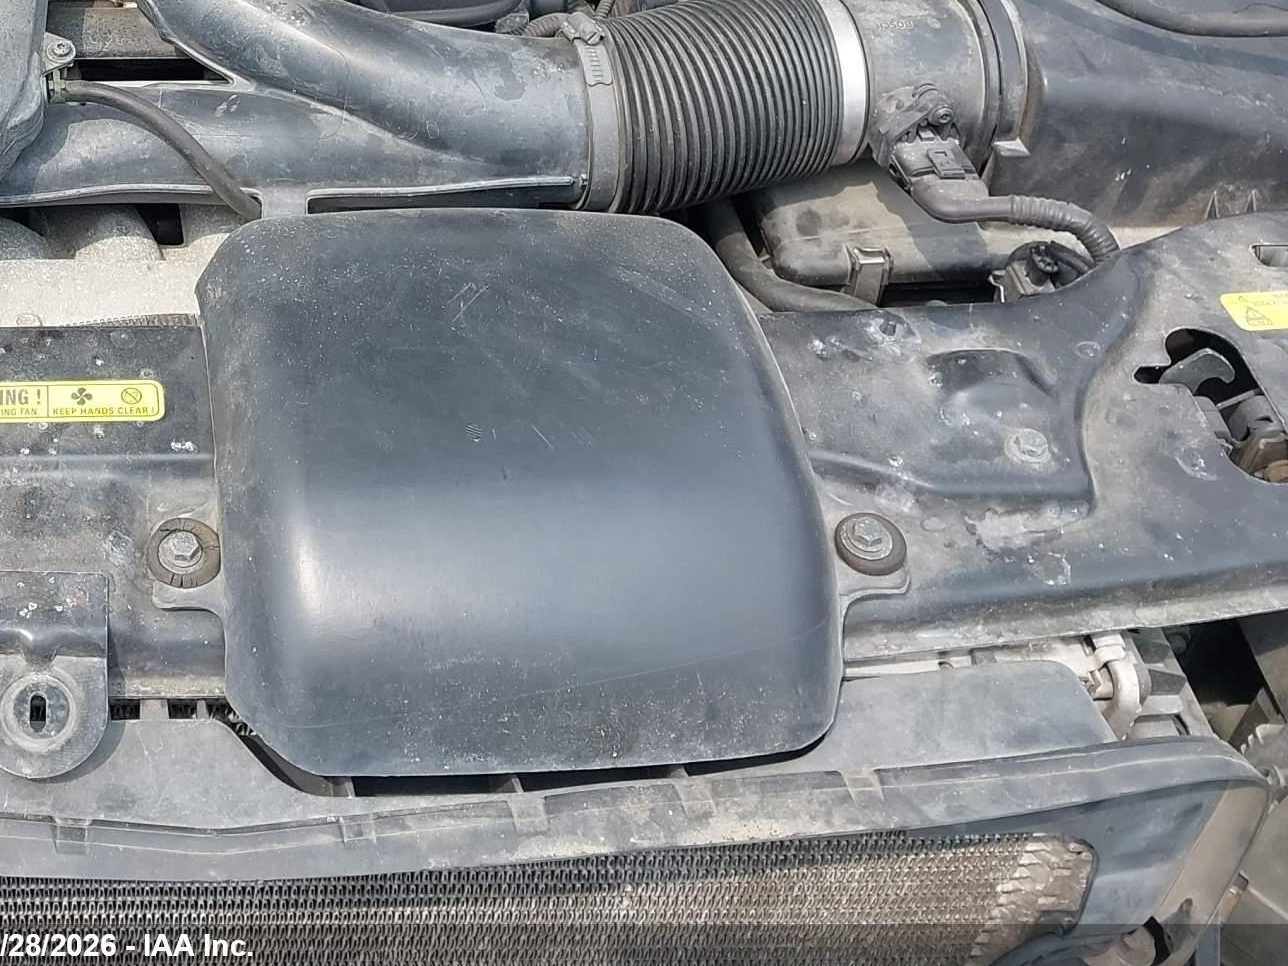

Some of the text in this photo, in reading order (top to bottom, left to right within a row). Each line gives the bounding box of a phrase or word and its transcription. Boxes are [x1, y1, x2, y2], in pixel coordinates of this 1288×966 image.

[19, 407, 38, 416] FAN
[52, 407, 78, 416] KEEP
[80, 407, 115, 415] HANDS
[117, 406, 149, 415] CLEAR
